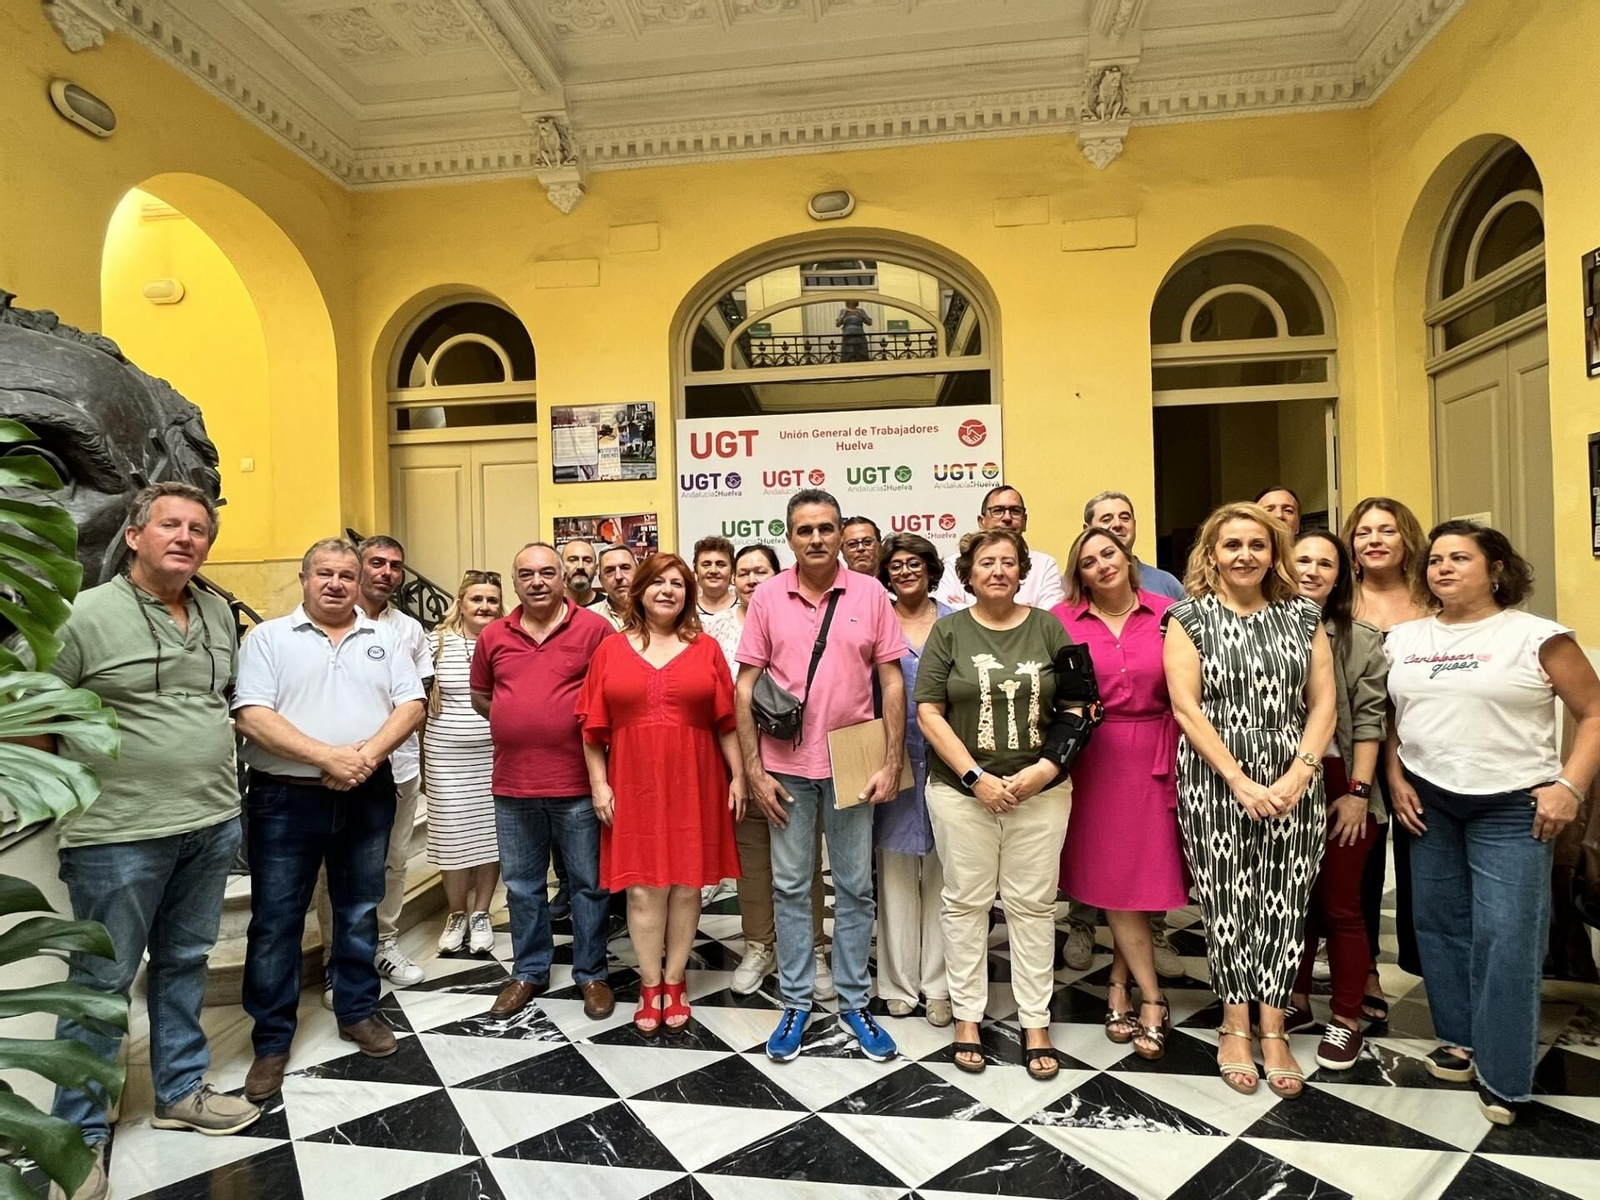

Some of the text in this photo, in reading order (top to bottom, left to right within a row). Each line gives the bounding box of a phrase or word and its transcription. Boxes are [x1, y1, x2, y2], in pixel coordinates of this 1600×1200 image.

[779, 424, 939, 440] Unión General de Trabajadores
[690, 430, 760, 460] UGT
[836, 440, 874, 451] Huelva
[762, 470, 805, 488] UGT
[846, 466, 891, 485] UGT
[933, 463, 978, 481] UGT
[680, 473, 722, 491] UGT
[721, 519, 765, 538] UGT
[891, 514, 935, 533] UGT
[1403, 652, 1474, 665] Caribbean
[1429, 660, 1479, 680] queen
